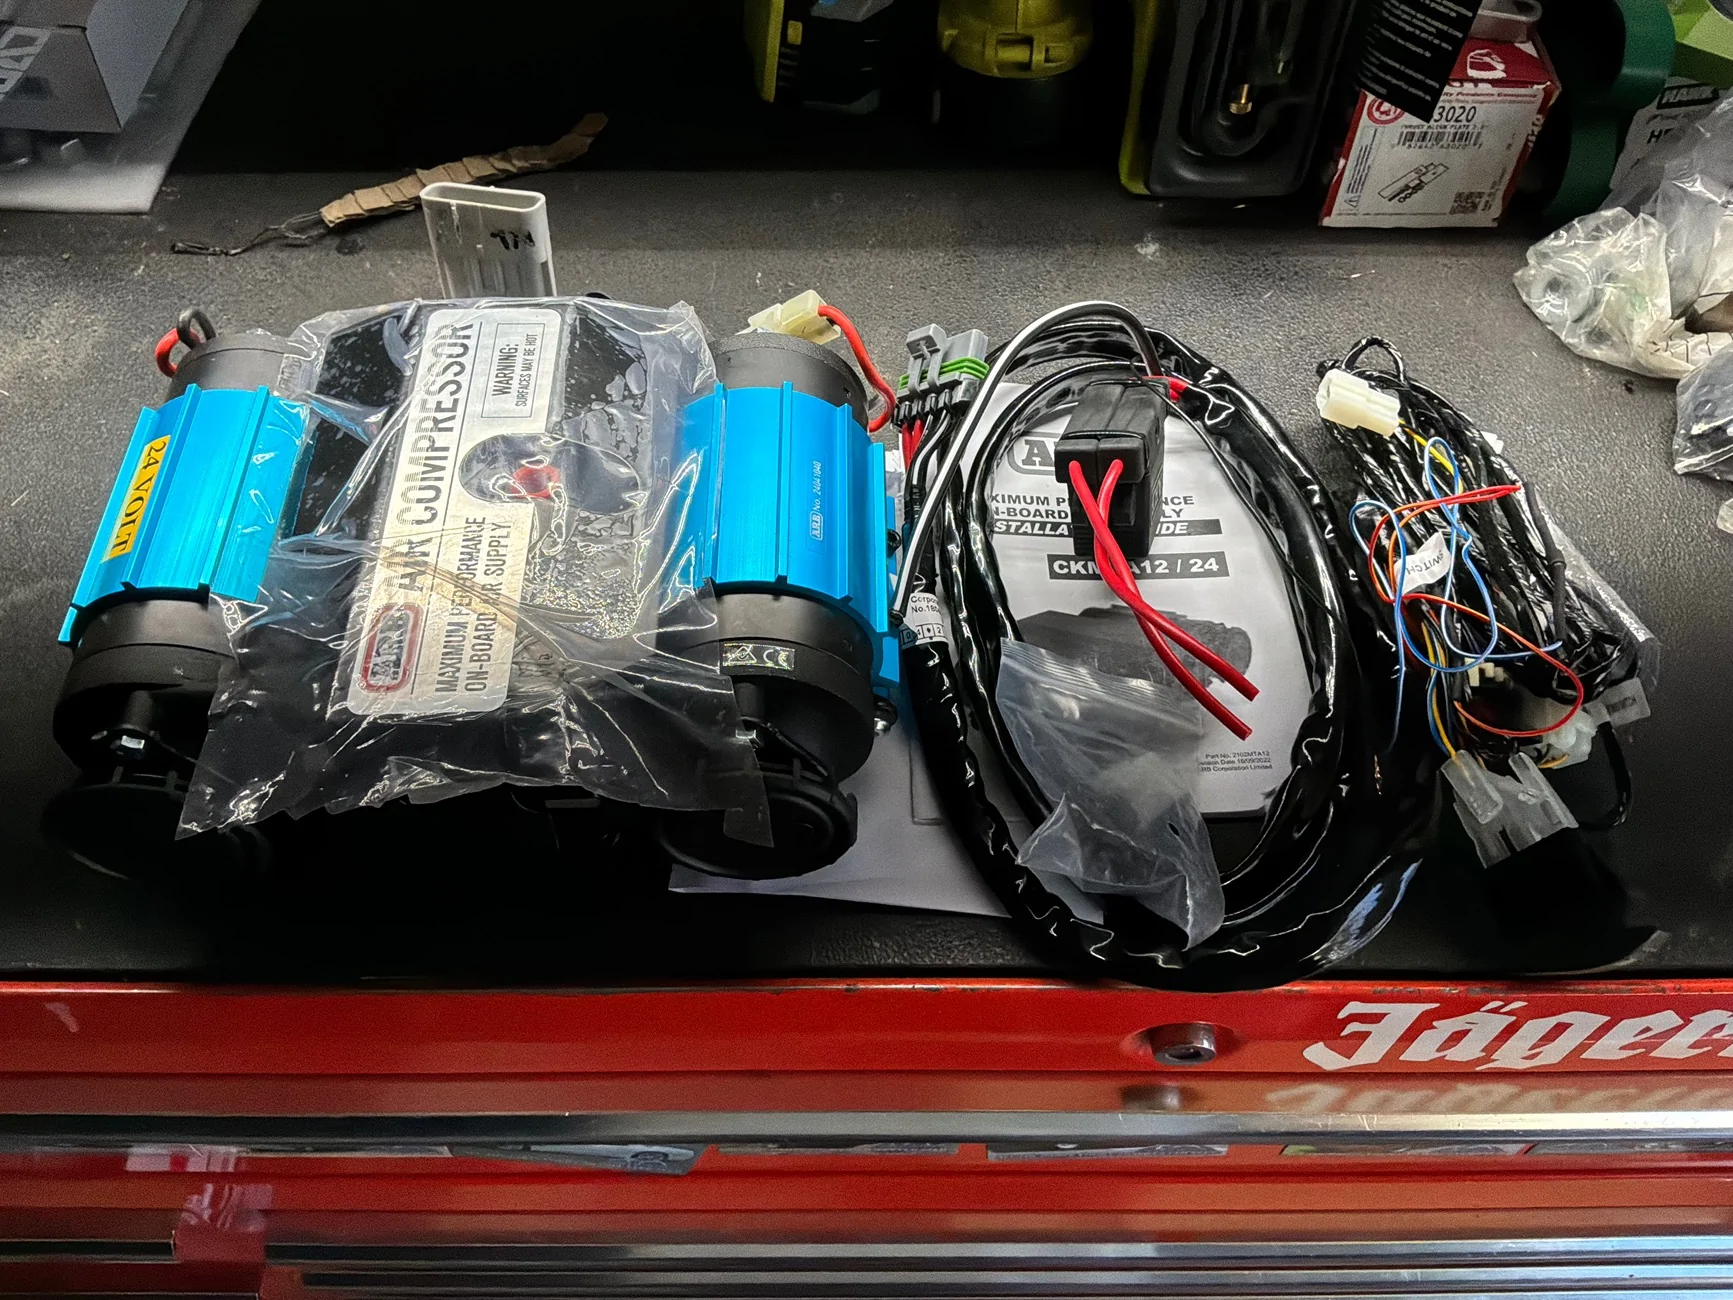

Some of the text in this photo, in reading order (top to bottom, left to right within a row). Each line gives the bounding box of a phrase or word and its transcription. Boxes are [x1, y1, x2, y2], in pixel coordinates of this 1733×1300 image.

[1433, 105, 1477, 123] 3020
[491, 343, 519, 396] WARNING:
[515, 333, 538, 407] SURFACES MAY BE HOT
[396, 323, 474, 525] COMPRESSOR
[112, 441, 167, 553] 24 VOLT
[812, 498, 821, 512] No.
[991, 493, 1051, 507] XIMUM
[810, 513, 822, 539] ARB
[993, 506, 1069, 520] N-BOARD
[993, 519, 1189, 536] STALLA IDE
[1189, 558, 1219, 573] 24
[1405, 550, 1444, 576] SWITCH
[464, 612, 498, 692] ON-BOARD
[483, 523, 512, 577] SUPPLY
[911, 596, 938, 604] Corpo
[435, 621, 469, 692] MAXIMUM
